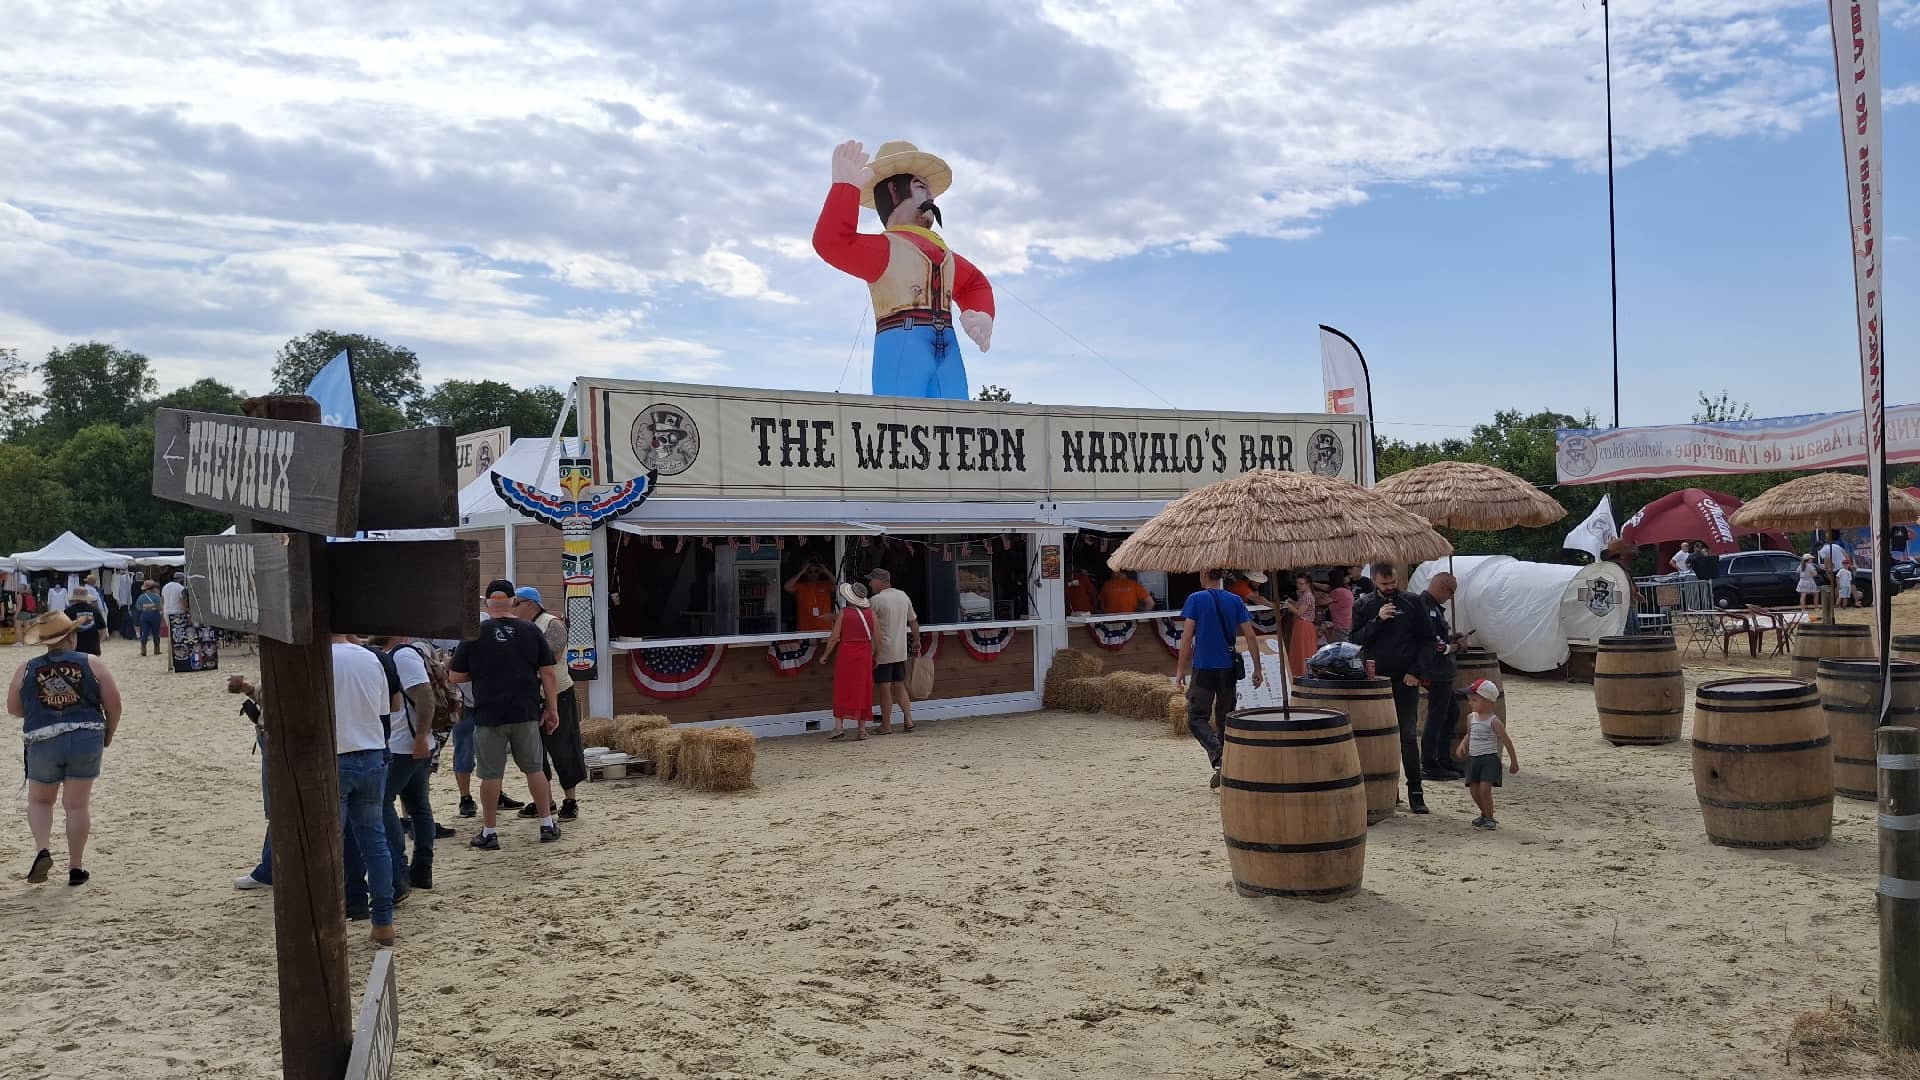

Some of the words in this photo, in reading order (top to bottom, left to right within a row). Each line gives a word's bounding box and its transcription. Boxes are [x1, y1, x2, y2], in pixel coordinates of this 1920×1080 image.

[185, 420, 295, 513] CHEVAUX
[456, 444, 473, 469] UE
[751, 417, 835, 468] THE
[851, 421, 1026, 472] WESTERN
[1061, 428, 1227, 474] NARVALO'S
[1240, 434, 1294, 472] BAR
[1703, 498, 1734, 543] Indian
[206, 543, 259, 624] INDIENS
[37, 667, 83, 682] LADY
